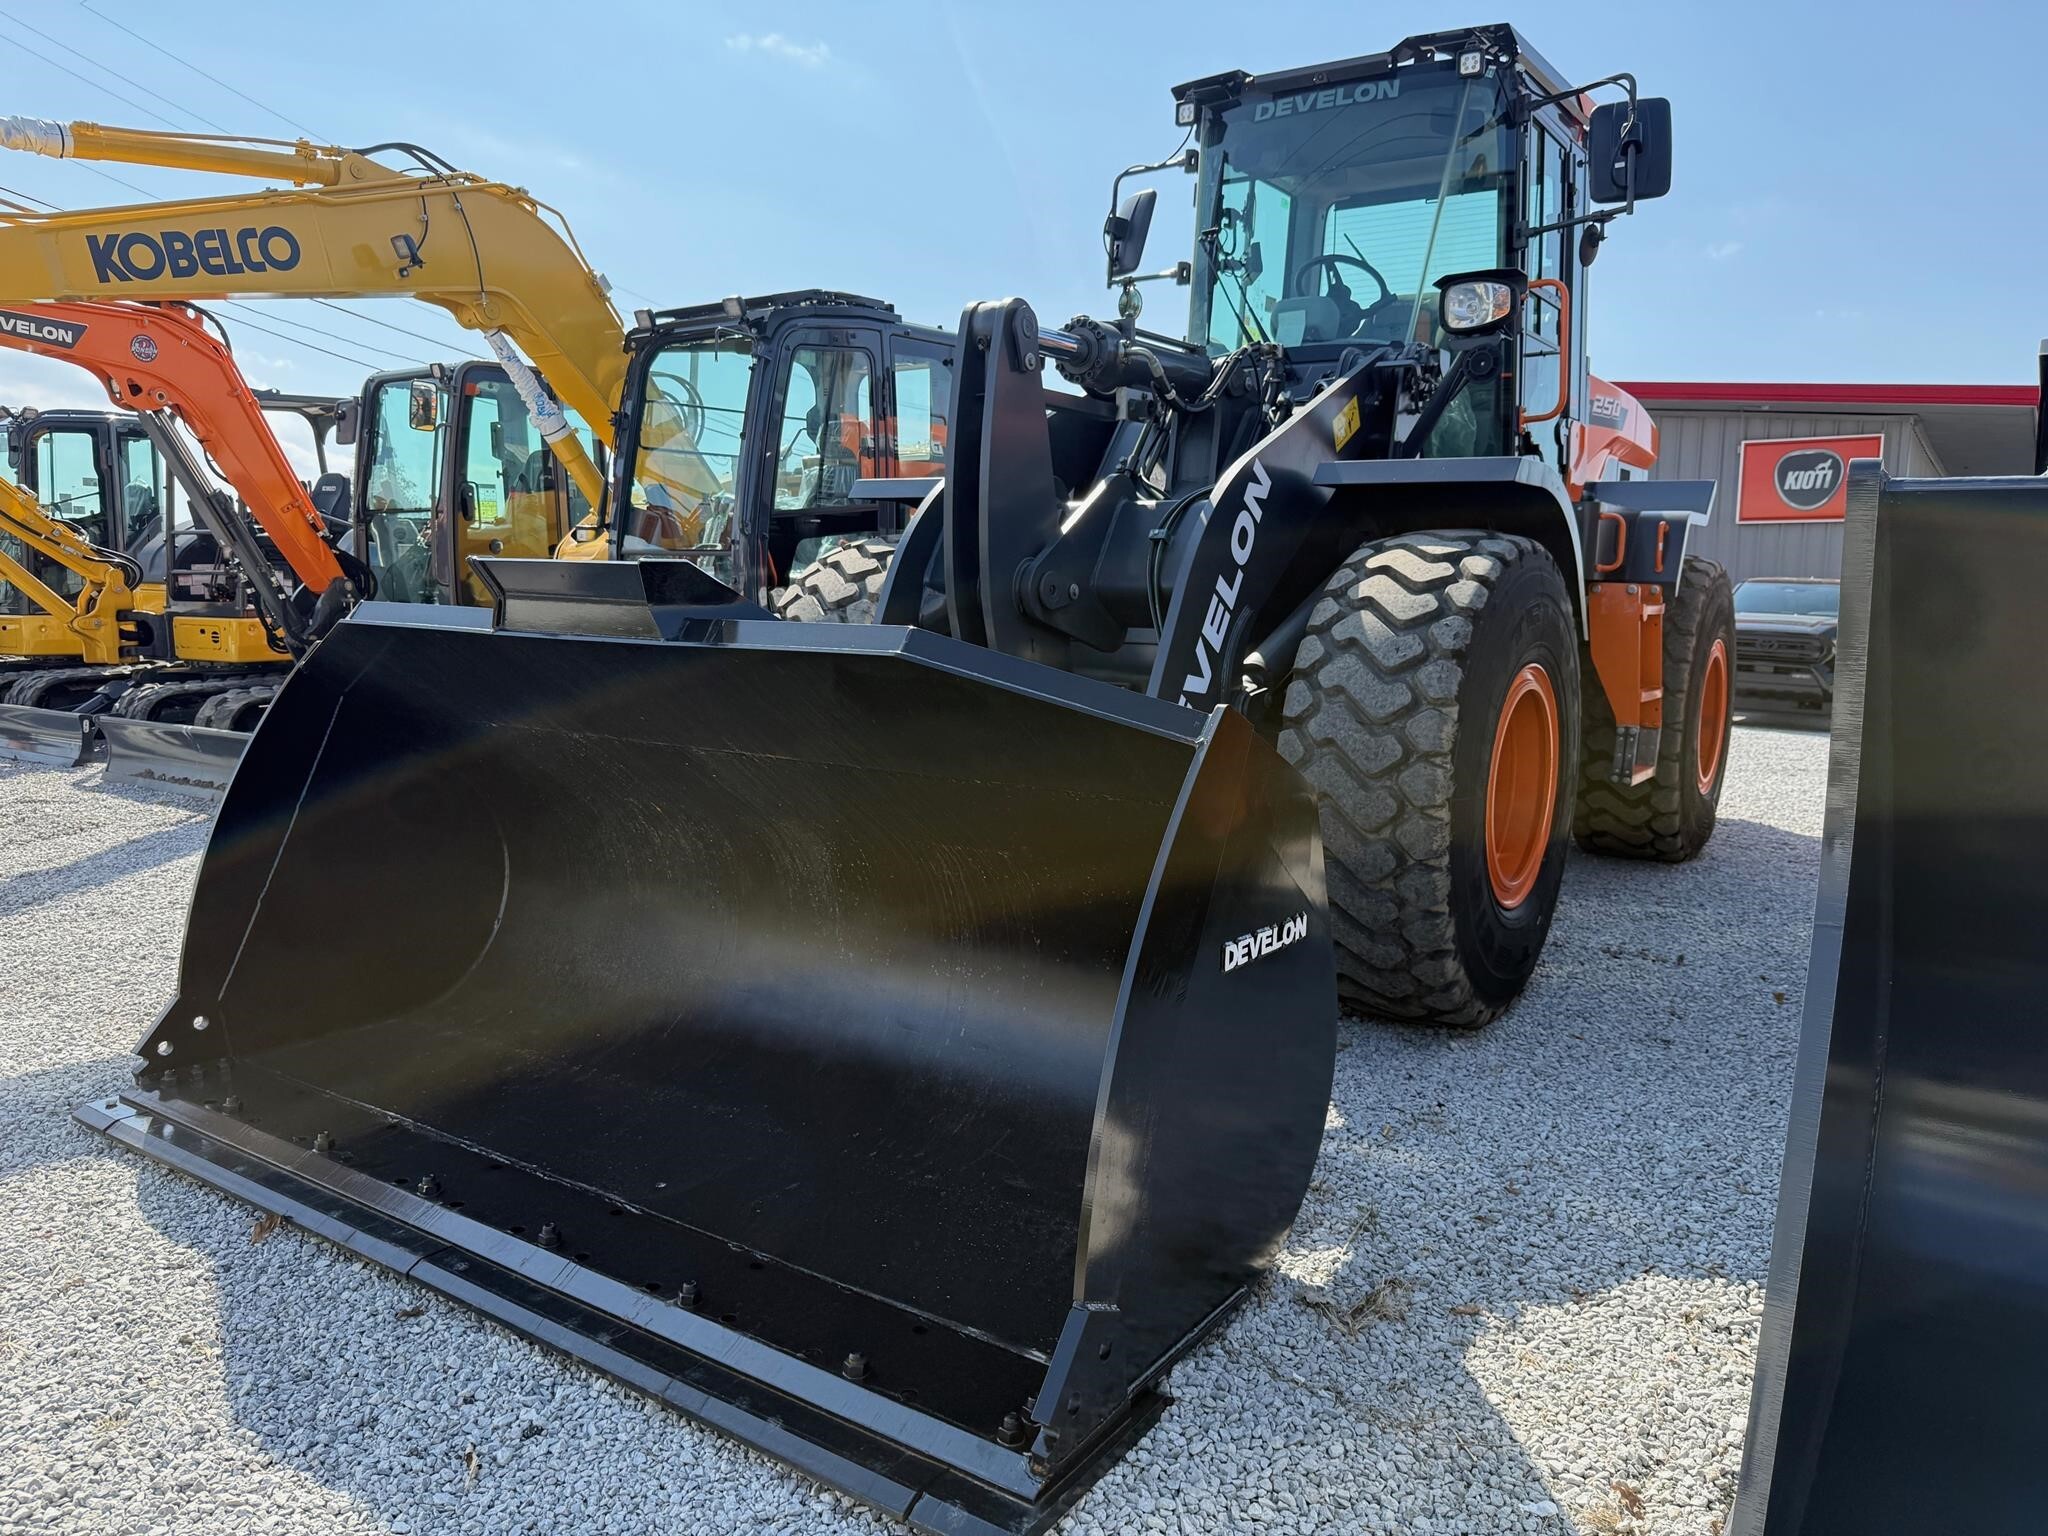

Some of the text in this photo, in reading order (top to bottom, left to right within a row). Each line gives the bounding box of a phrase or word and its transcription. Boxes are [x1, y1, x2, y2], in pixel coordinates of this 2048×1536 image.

[1254, 79, 1400, 122] DEVELON
[85, 226, 301, 284] KOBELCO
[1783, 469, 1833, 490] KIOTI
[1178, 458, 1272, 709] VELON
[1224, 911, 1308, 972] DEVELON
